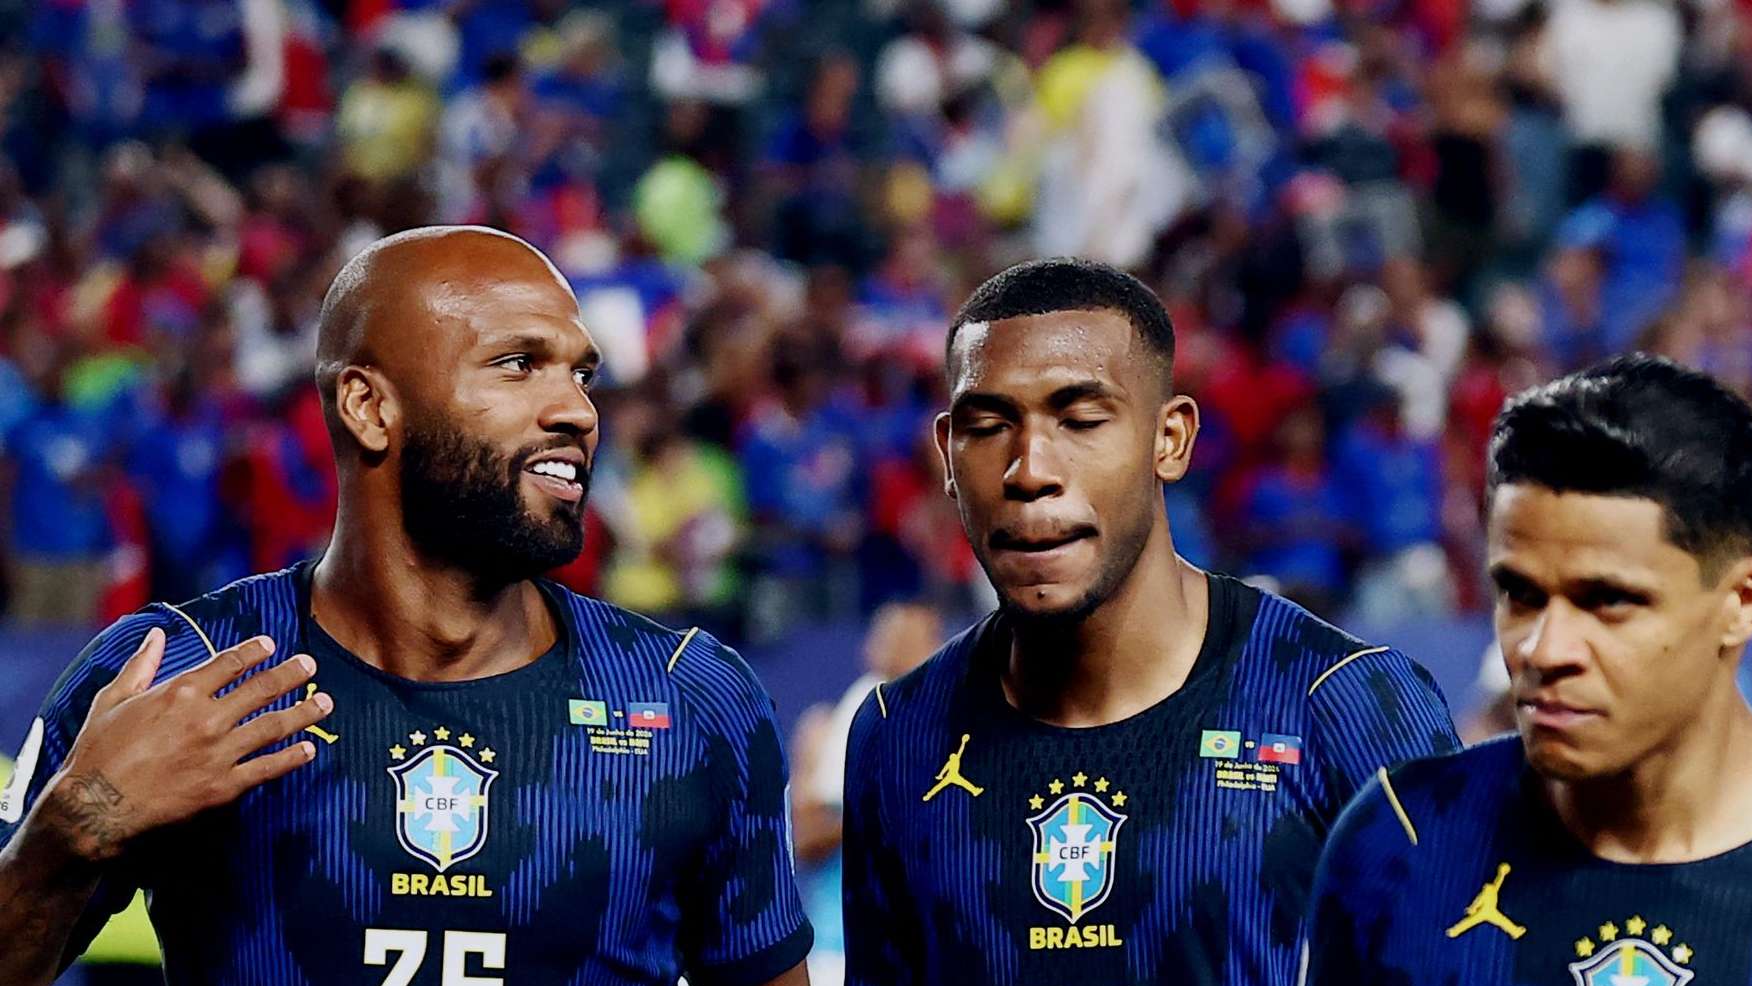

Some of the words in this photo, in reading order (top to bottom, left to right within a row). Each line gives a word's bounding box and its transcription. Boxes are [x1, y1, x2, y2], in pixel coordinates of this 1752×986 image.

[425, 797, 458, 810] CBF
[1059, 846, 1090, 860] CBF
[391, 873, 493, 897] BRASIL
[1029, 925, 1123, 950] BRASIL
